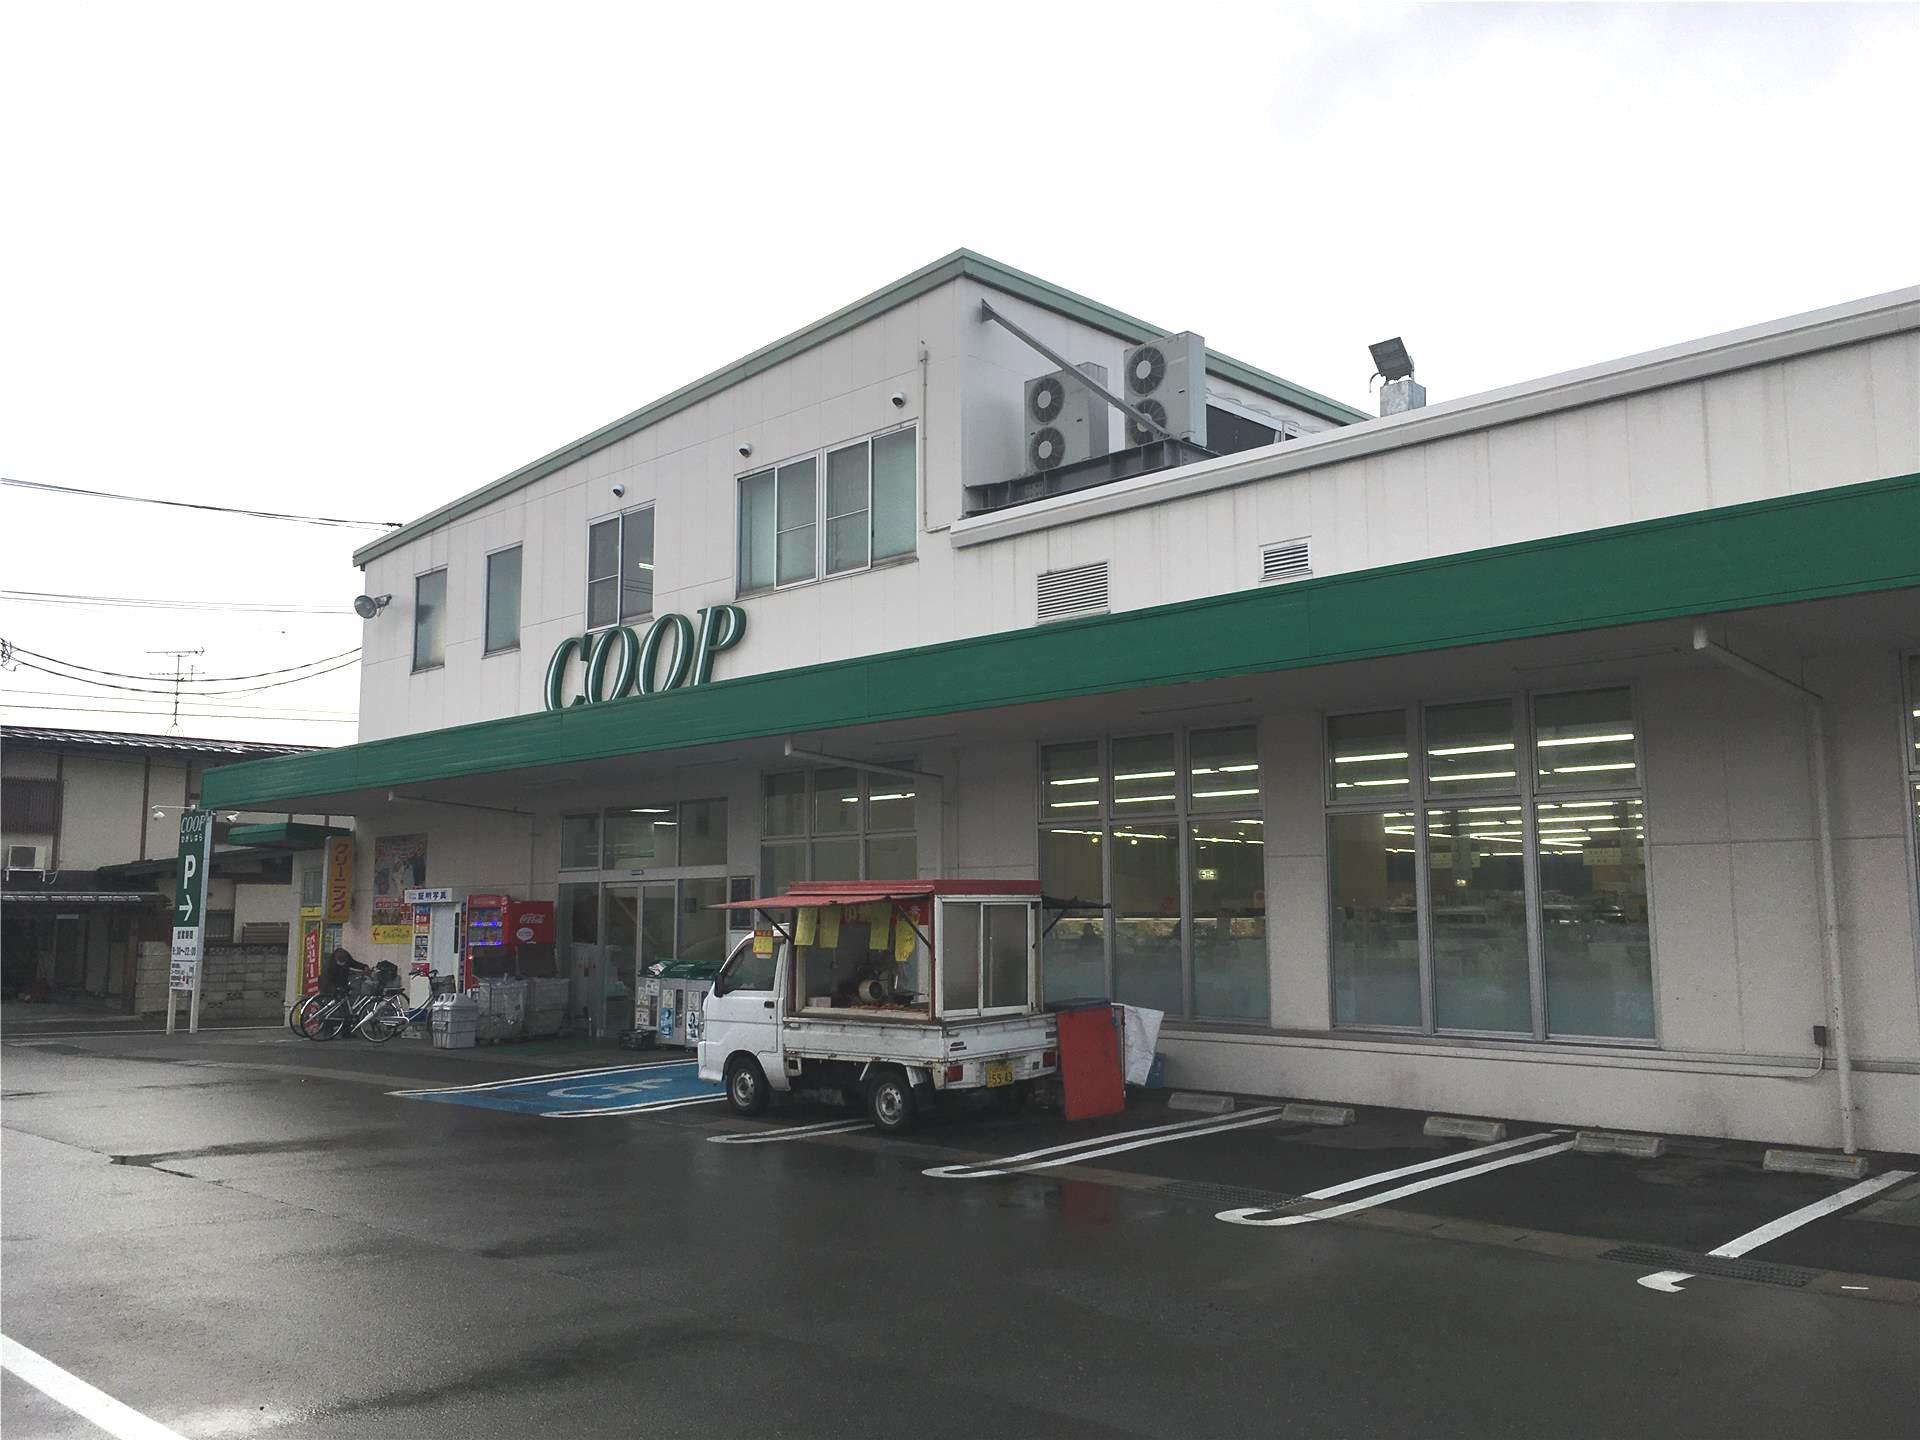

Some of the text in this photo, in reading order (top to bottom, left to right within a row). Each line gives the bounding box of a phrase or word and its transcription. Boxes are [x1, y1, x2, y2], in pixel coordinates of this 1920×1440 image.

[544, 604, 747, 711] COOP
[181, 815, 206, 834] COOP
[183, 854, 197, 890] P
[331, 844, 349, 913] クリーニング
